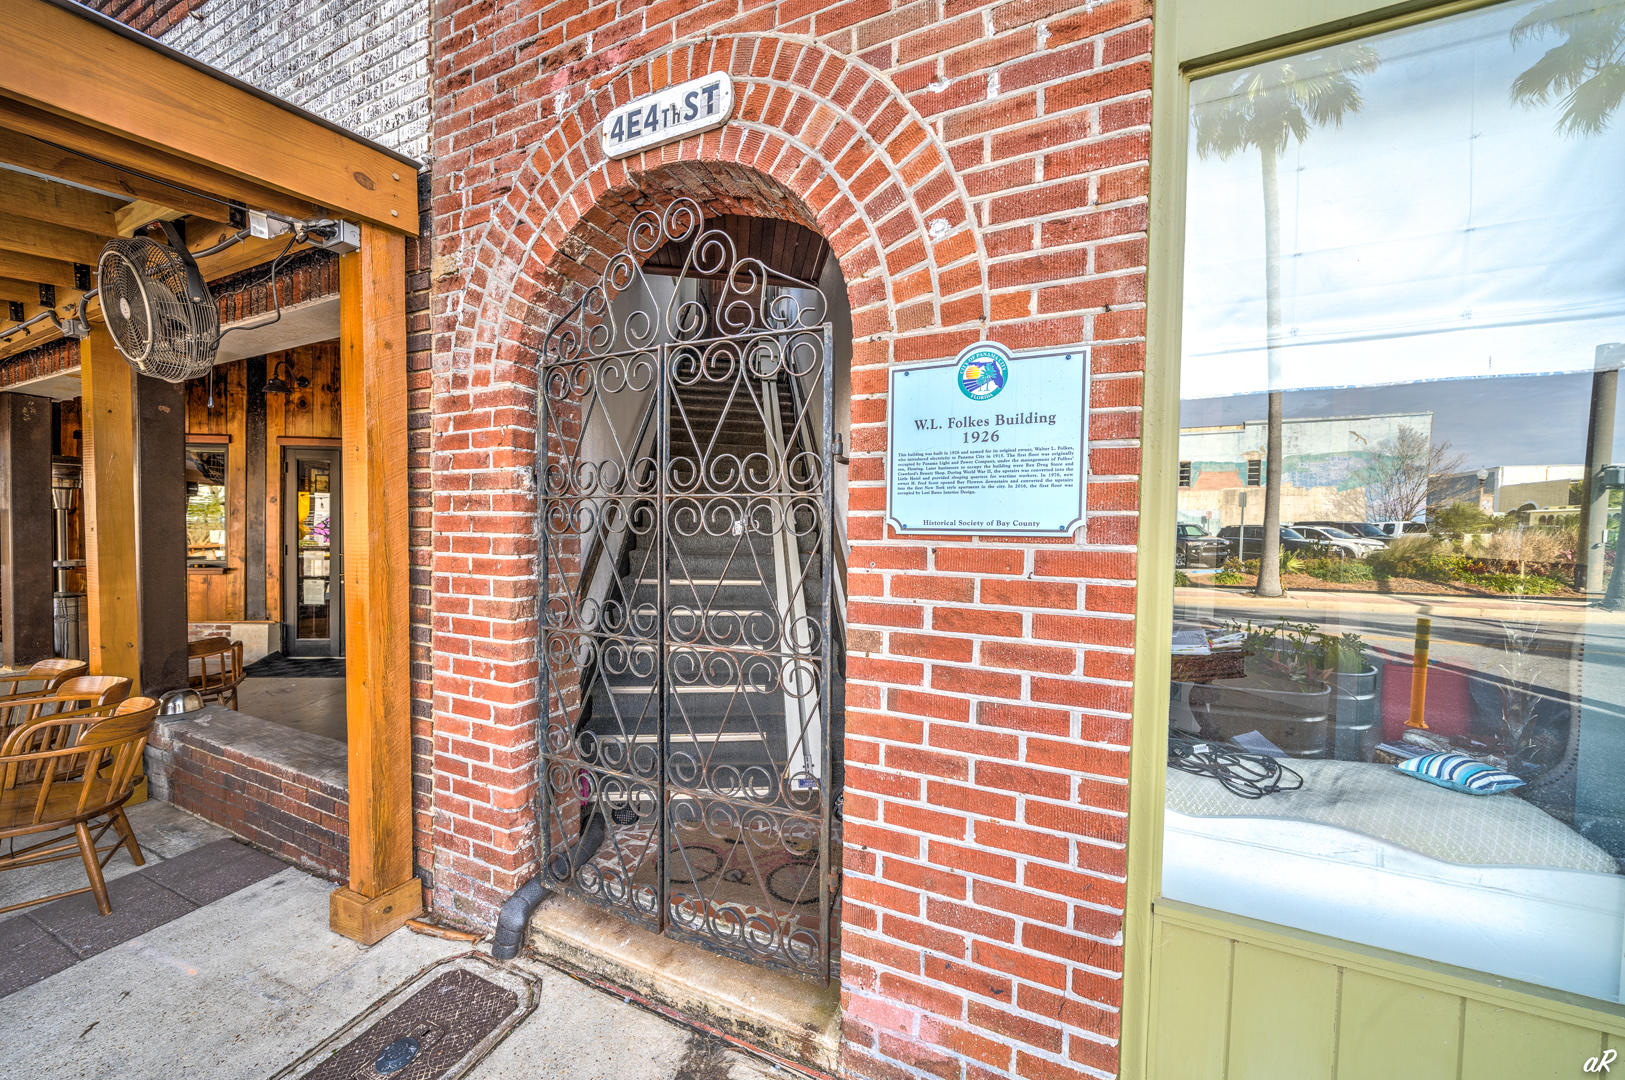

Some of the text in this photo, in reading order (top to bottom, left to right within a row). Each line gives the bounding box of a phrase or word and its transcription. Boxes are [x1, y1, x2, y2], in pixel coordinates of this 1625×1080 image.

[914, 412, 1056, 430] W.L. Folkes Building
[963, 430, 1000, 444] 1926
